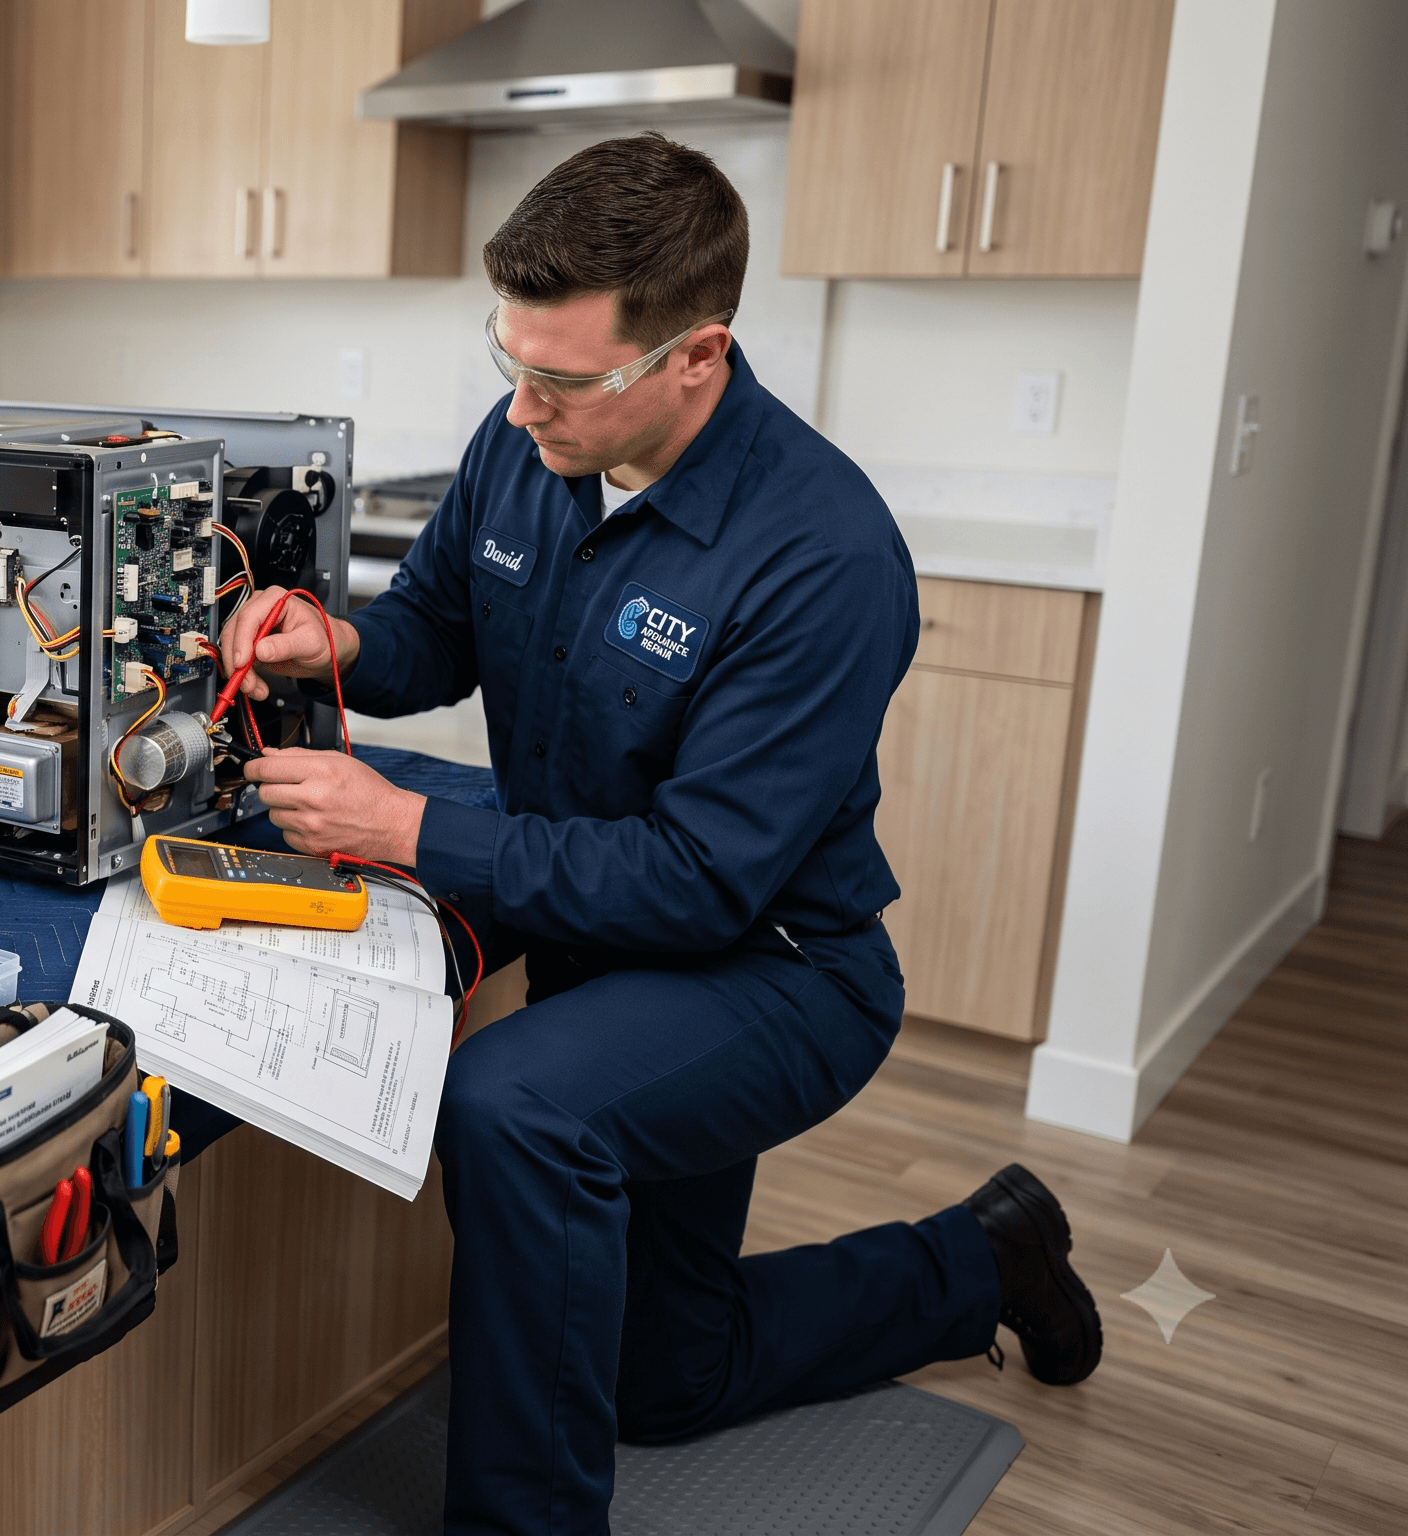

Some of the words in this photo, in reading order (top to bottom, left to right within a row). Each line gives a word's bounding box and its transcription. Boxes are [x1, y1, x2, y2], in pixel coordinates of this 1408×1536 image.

[483, 539, 524, 571] David
[647, 608, 697, 643] CITY
[640, 637, 673, 661] REPAIR
